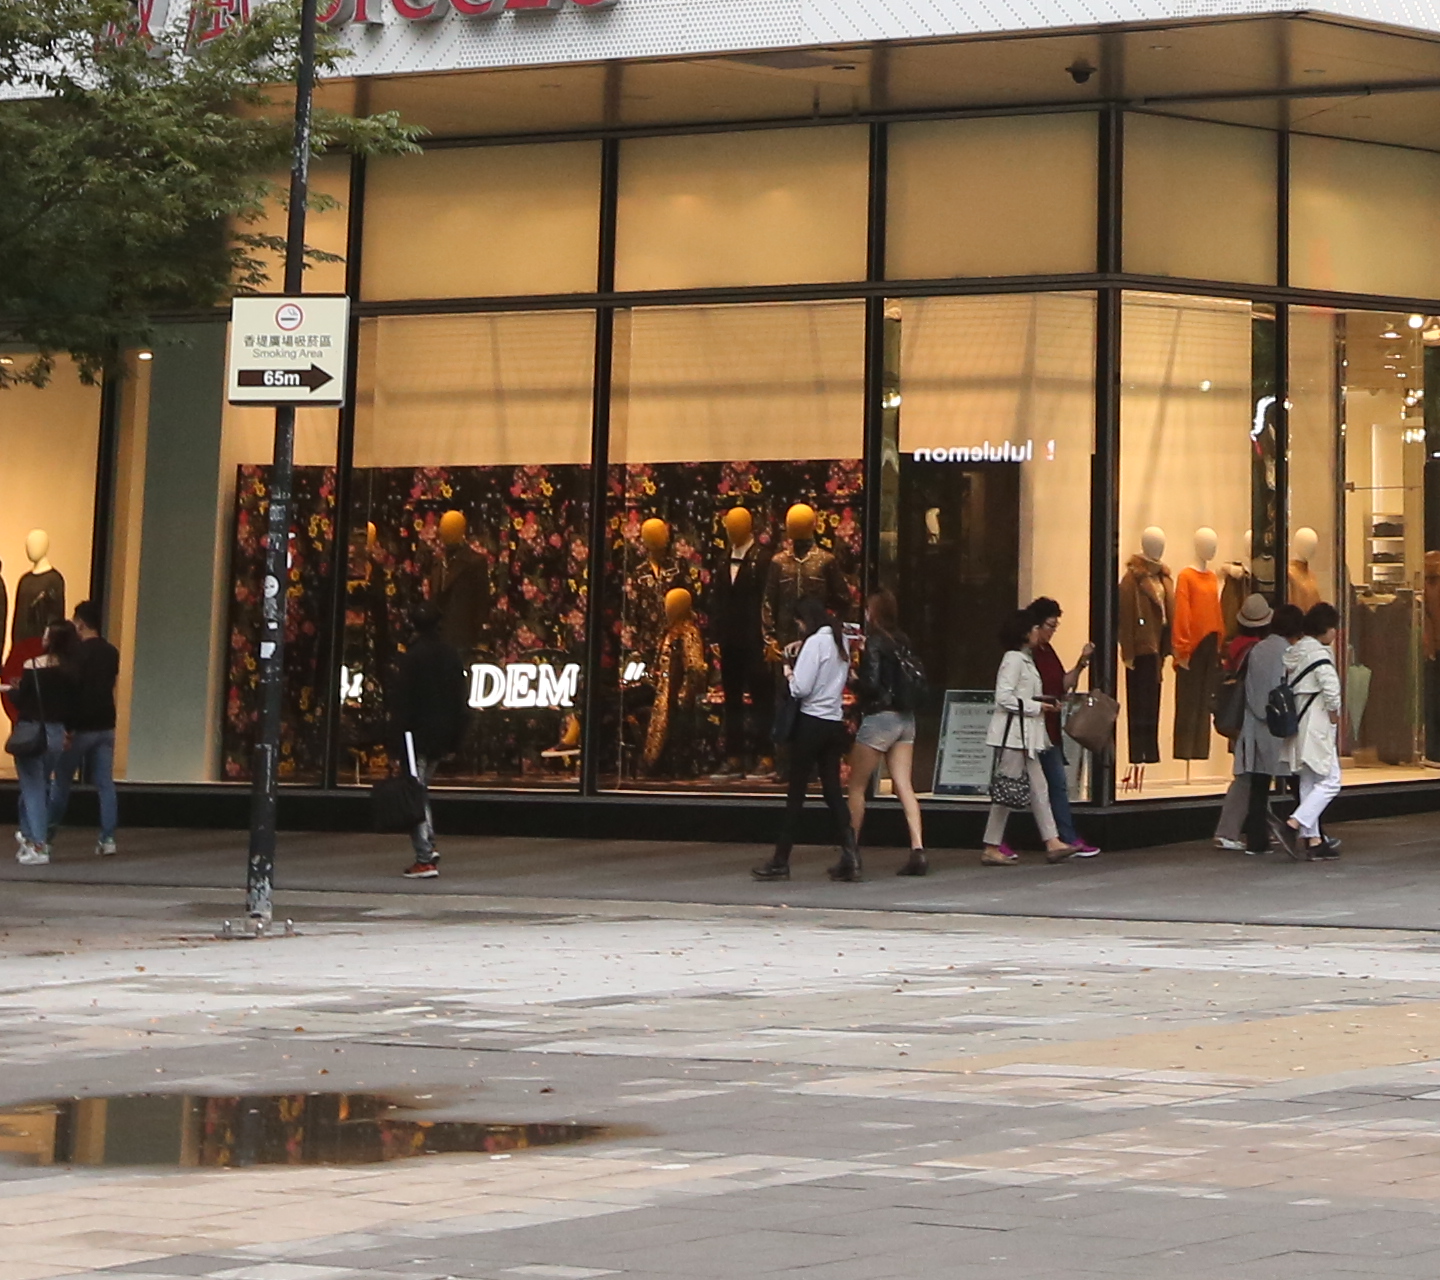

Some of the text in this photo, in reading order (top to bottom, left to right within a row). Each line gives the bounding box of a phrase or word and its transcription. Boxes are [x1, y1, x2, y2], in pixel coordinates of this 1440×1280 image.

[253, 349, 323, 360] Smoking Area
[263, 370, 301, 386] 65m
